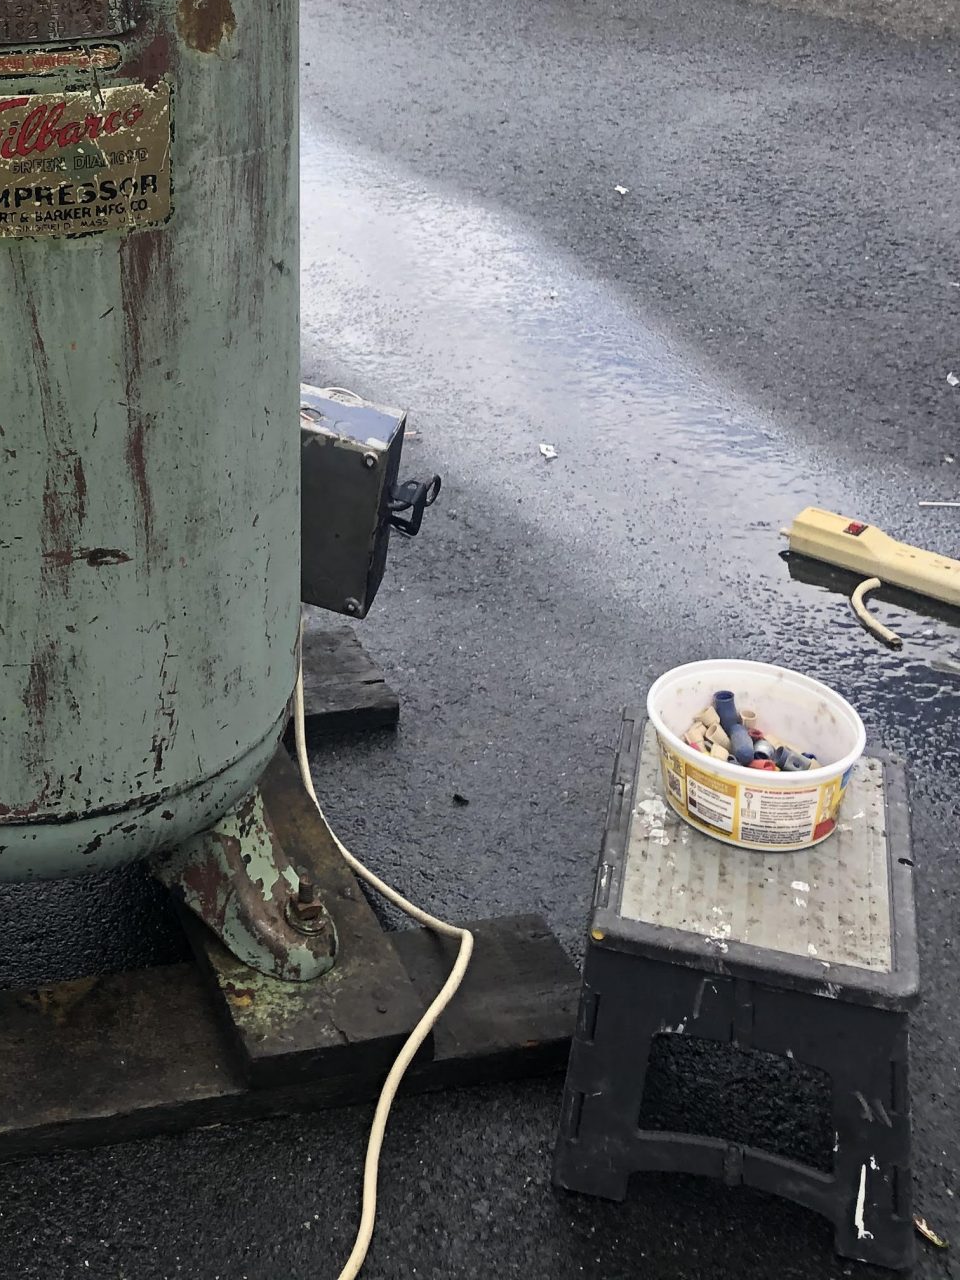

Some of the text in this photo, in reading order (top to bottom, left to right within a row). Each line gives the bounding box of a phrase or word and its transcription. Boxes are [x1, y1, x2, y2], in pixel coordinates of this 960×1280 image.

[10, 148, 149, 175] GREEN DIAMOND
[20, 211, 29, 223] &
[35, 206, 92, 222] BARKER
